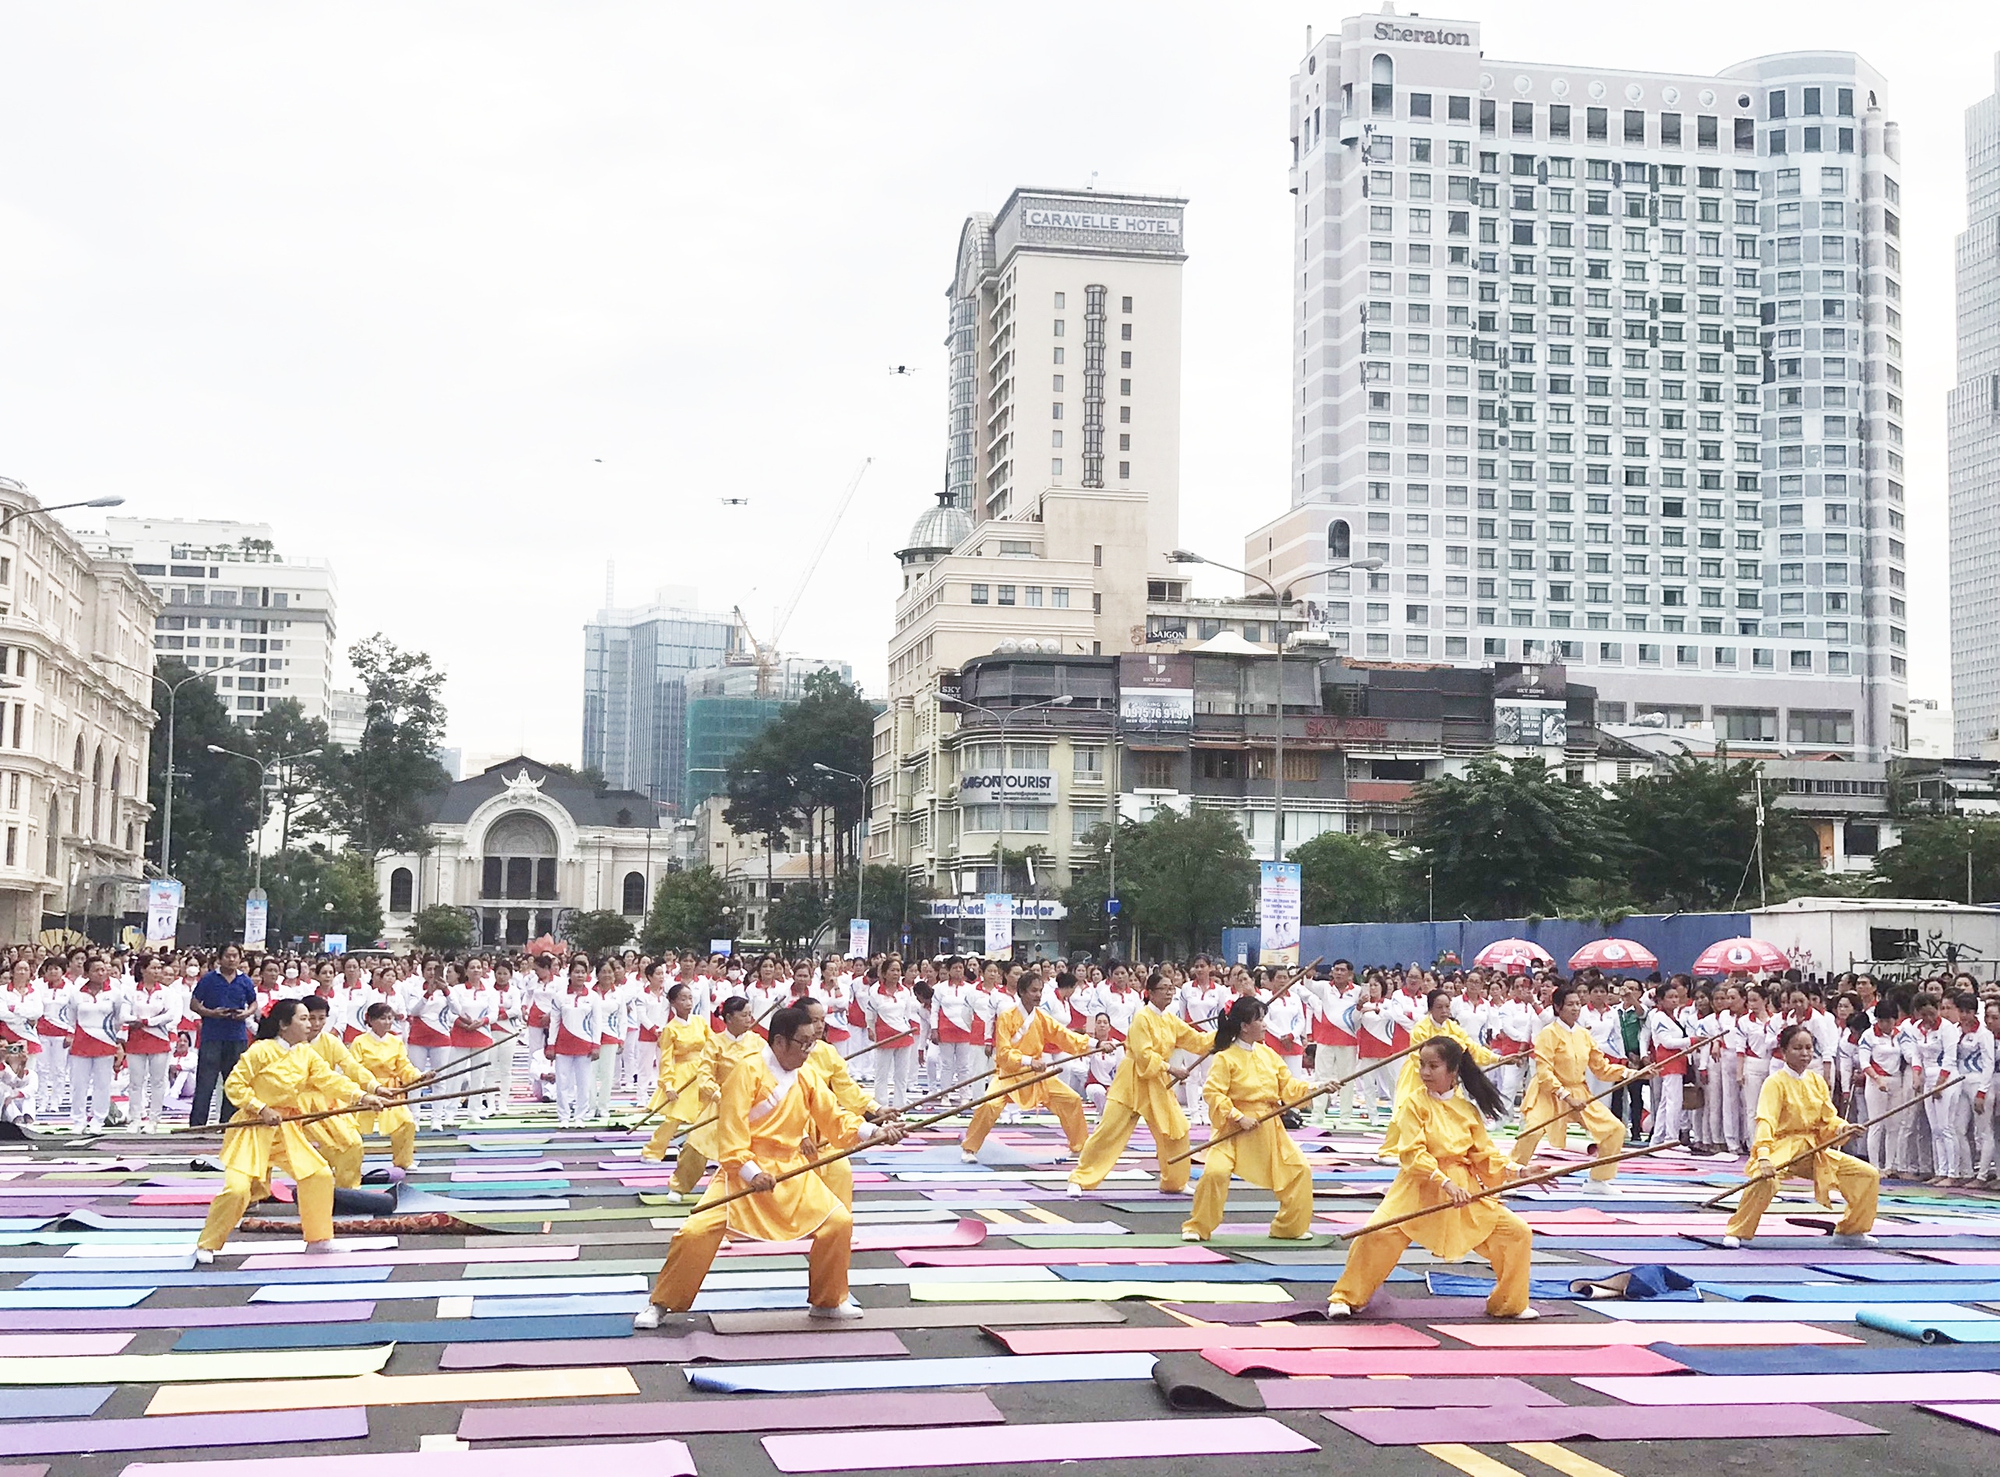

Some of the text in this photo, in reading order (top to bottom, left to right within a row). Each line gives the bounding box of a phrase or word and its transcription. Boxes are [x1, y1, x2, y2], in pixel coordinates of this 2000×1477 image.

[1374, 22, 1470, 46] Sheraton
[1030, 211, 1175, 233] CARAVELLE HOTEL
[1152, 630, 1185, 640] SAIGON
[1306, 718, 1388, 737] SKY ZONE
